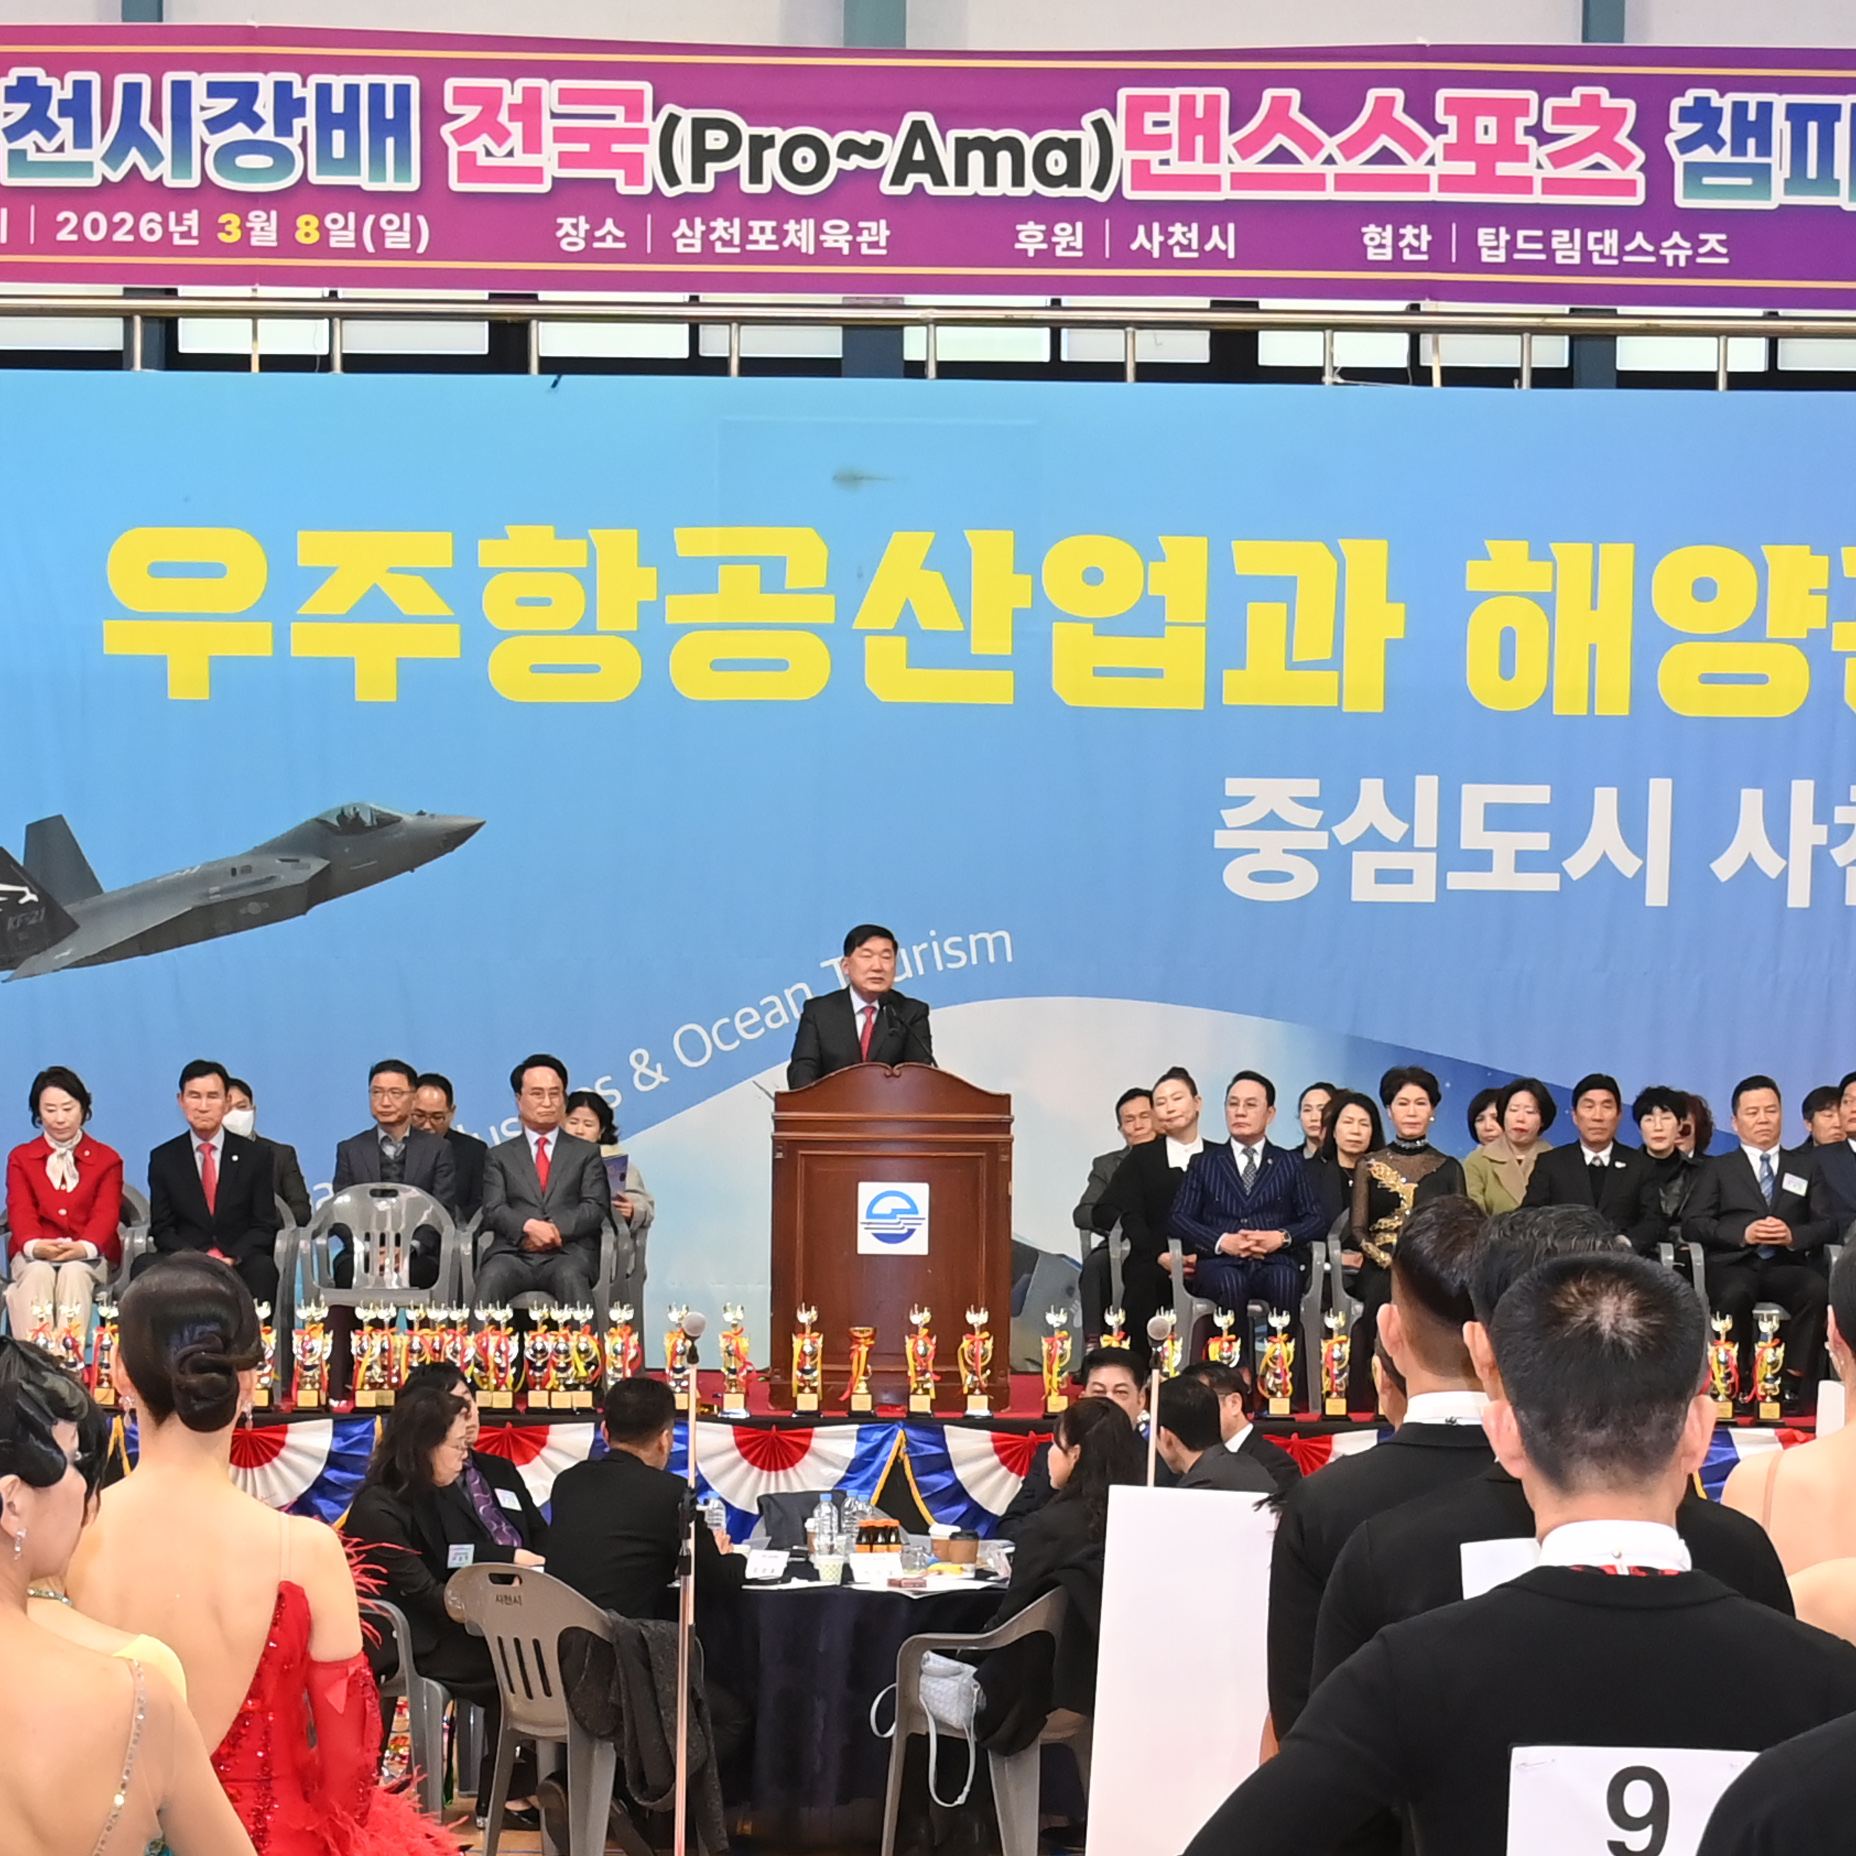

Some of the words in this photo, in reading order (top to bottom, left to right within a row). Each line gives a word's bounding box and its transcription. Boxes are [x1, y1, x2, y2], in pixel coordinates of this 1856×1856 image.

[55, 211, 201, 247] 2026년
[216, 209, 280, 247] 3월
[294, 211, 431, 252] 8일(일)
[555, 214, 627, 252] 장소
[670, 215, 891, 256] 삼천포체육관
[1014, 219, 1085, 258] 후원
[1130, 222, 1237, 259] 사천시
[1361, 223, 1433, 263] 협찬
[1477, 227, 1730, 267] 탑드림댄스슈즈
[102, 523, 1406, 714] 우주항공산업과
[1213, 773, 1671, 909] 중심도시
[628, 1047, 670, 1092] &
[672, 980, 816, 1068] Ocean
[820, 927, 1014, 992] Turism
